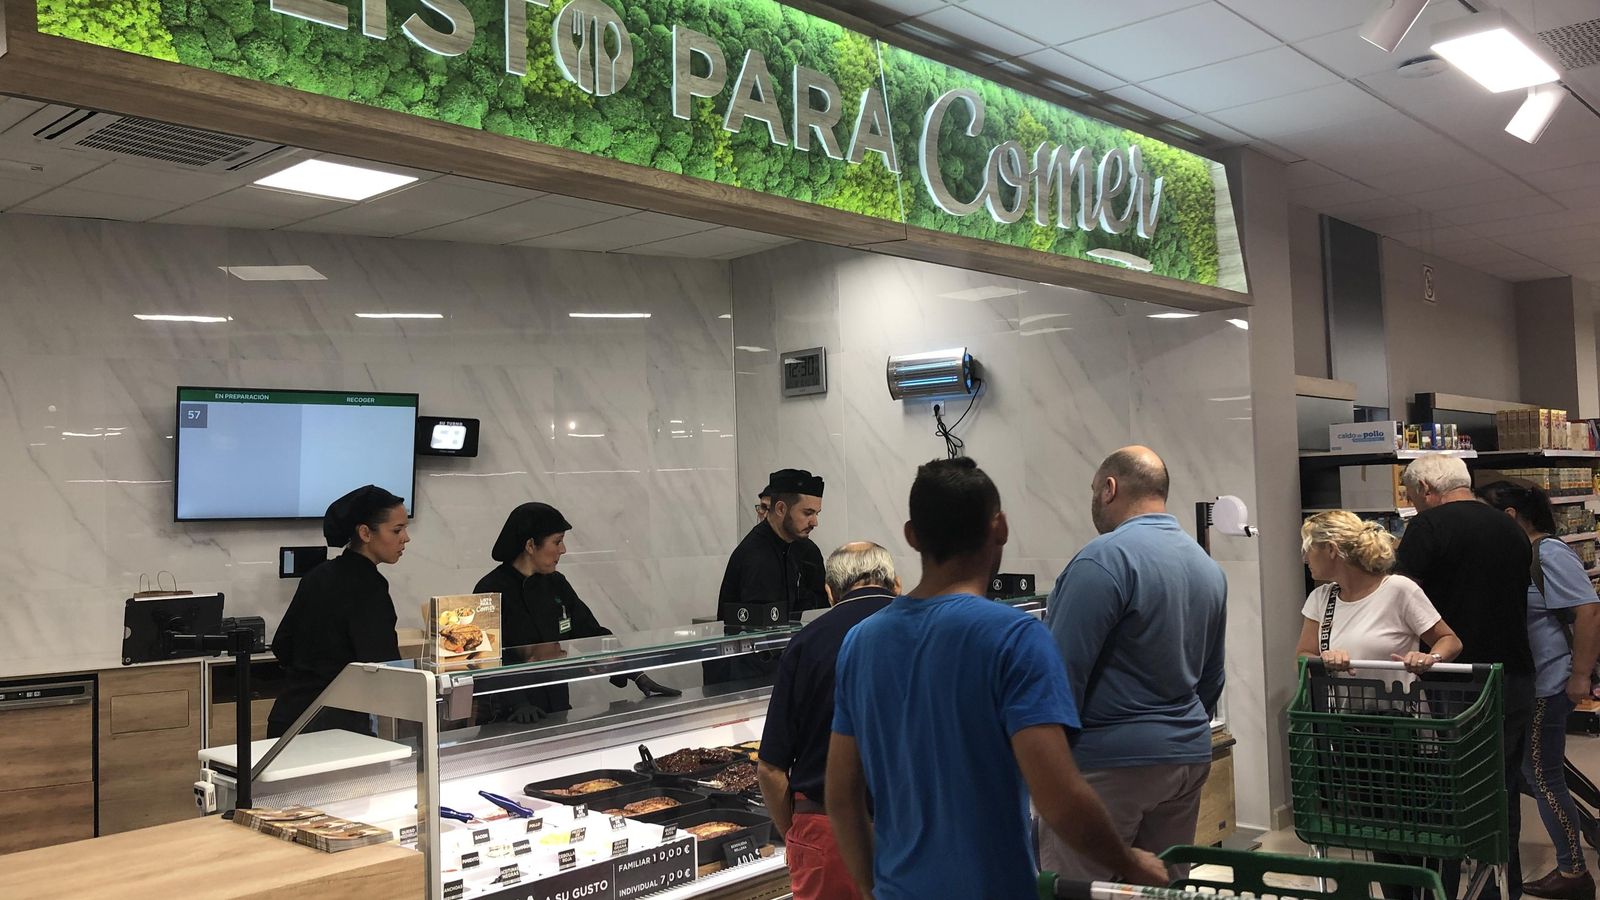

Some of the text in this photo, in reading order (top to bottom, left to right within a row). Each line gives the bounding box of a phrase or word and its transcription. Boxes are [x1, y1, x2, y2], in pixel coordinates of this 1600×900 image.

[672, 24, 902, 174] PARA
[919, 87, 1164, 240] Comer
[224, 393, 270, 401] PREPARACIÓN
[187, 410, 201, 420] 57
[1337, 431, 1357, 440] caldo
[1363, 430, 1384, 439] pollo
[474, 832, 489, 841] BACON
[618, 857, 651, 872] FAMILIAR
[555, 880, 608, 900] SU GUSTO
[619, 880, 659, 897] INDIVIDUAL
